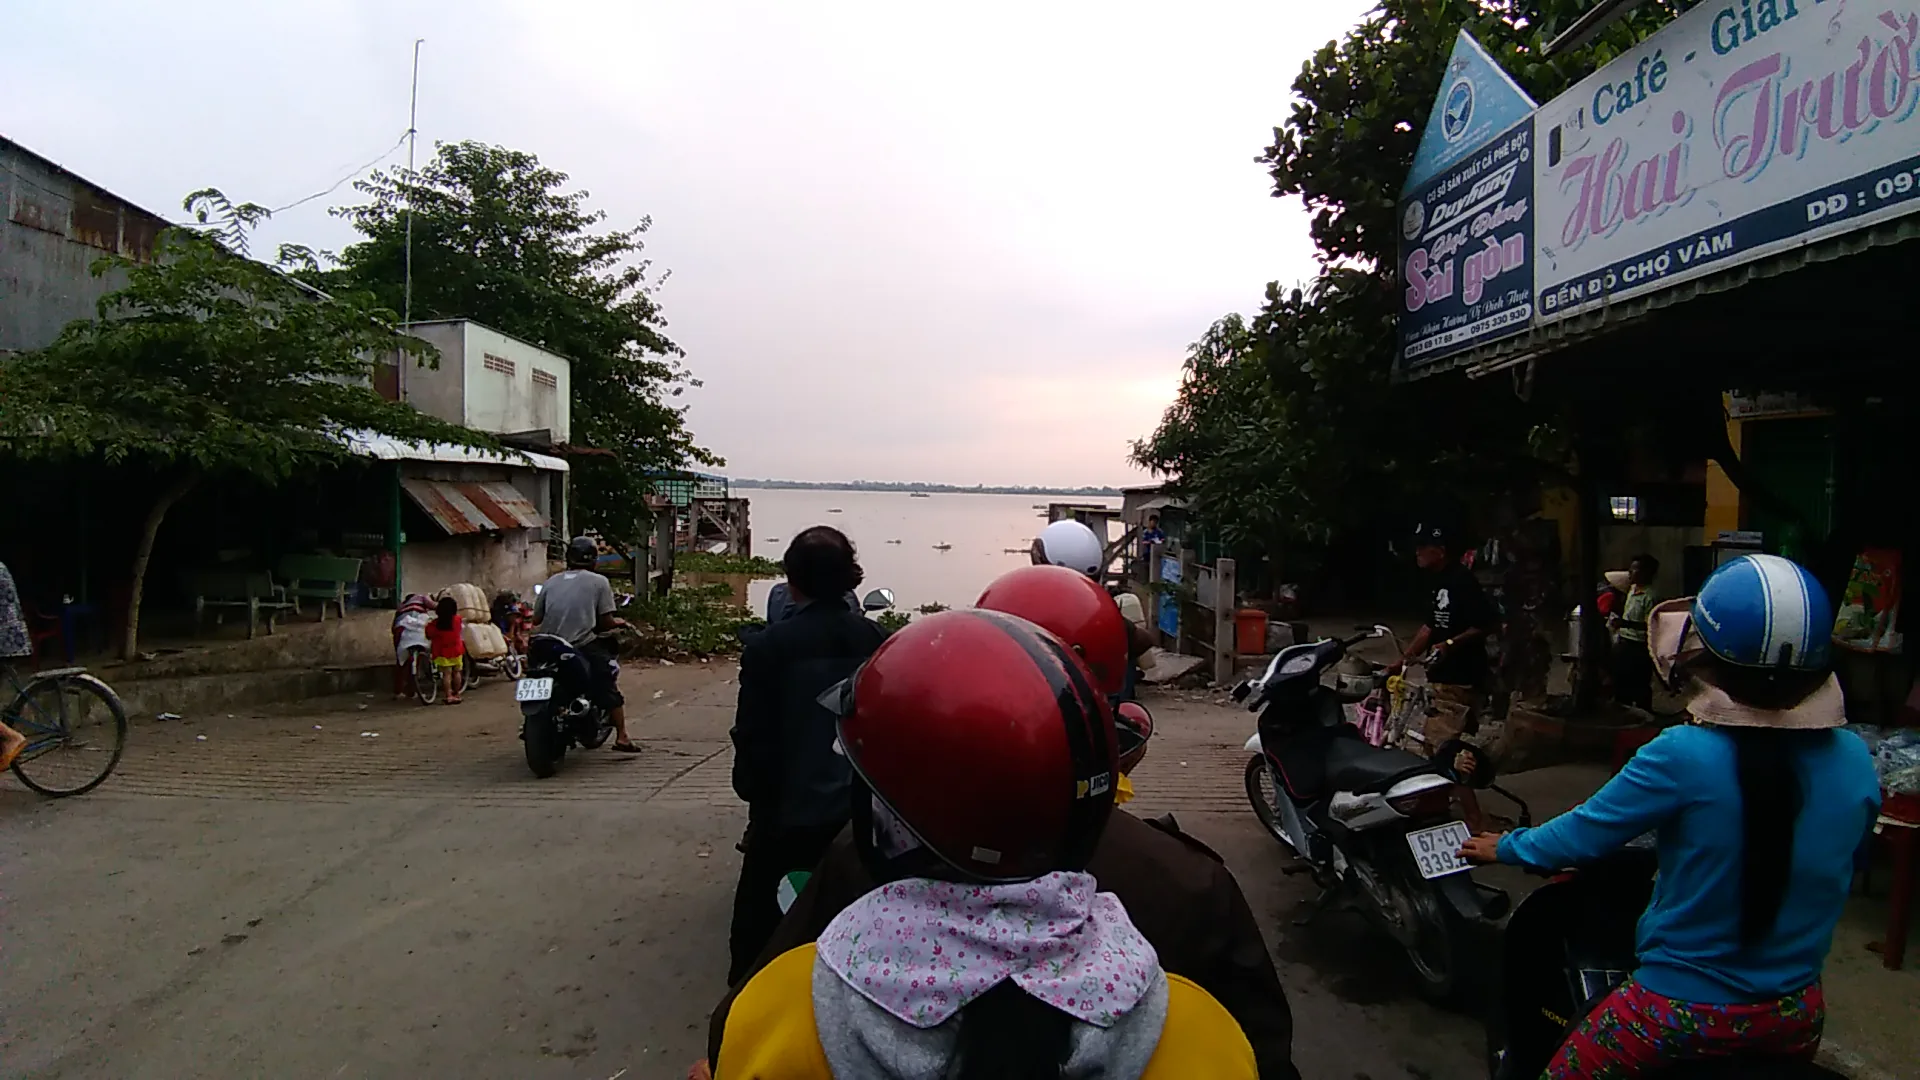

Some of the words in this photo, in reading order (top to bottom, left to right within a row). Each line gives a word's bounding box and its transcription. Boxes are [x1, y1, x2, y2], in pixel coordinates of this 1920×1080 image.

[1592, 49, 1668, 125] Café
[1559, 110, 1690, 248] Hai
[1405, 247, 1454, 312] Sài
[1463, 232, 1524, 306] gòn
[1545, 282, 1584, 310] BẾN
[1622, 250, 1672, 283] CHỢ
[1678, 231, 1734, 264] VÀM
[1807, 193, 1848, 222] DĐ
[1470, 320, 1490, 335] 0975
[1491, 314, 1508, 327] 330
[1509, 307, 1527, 321] 930
